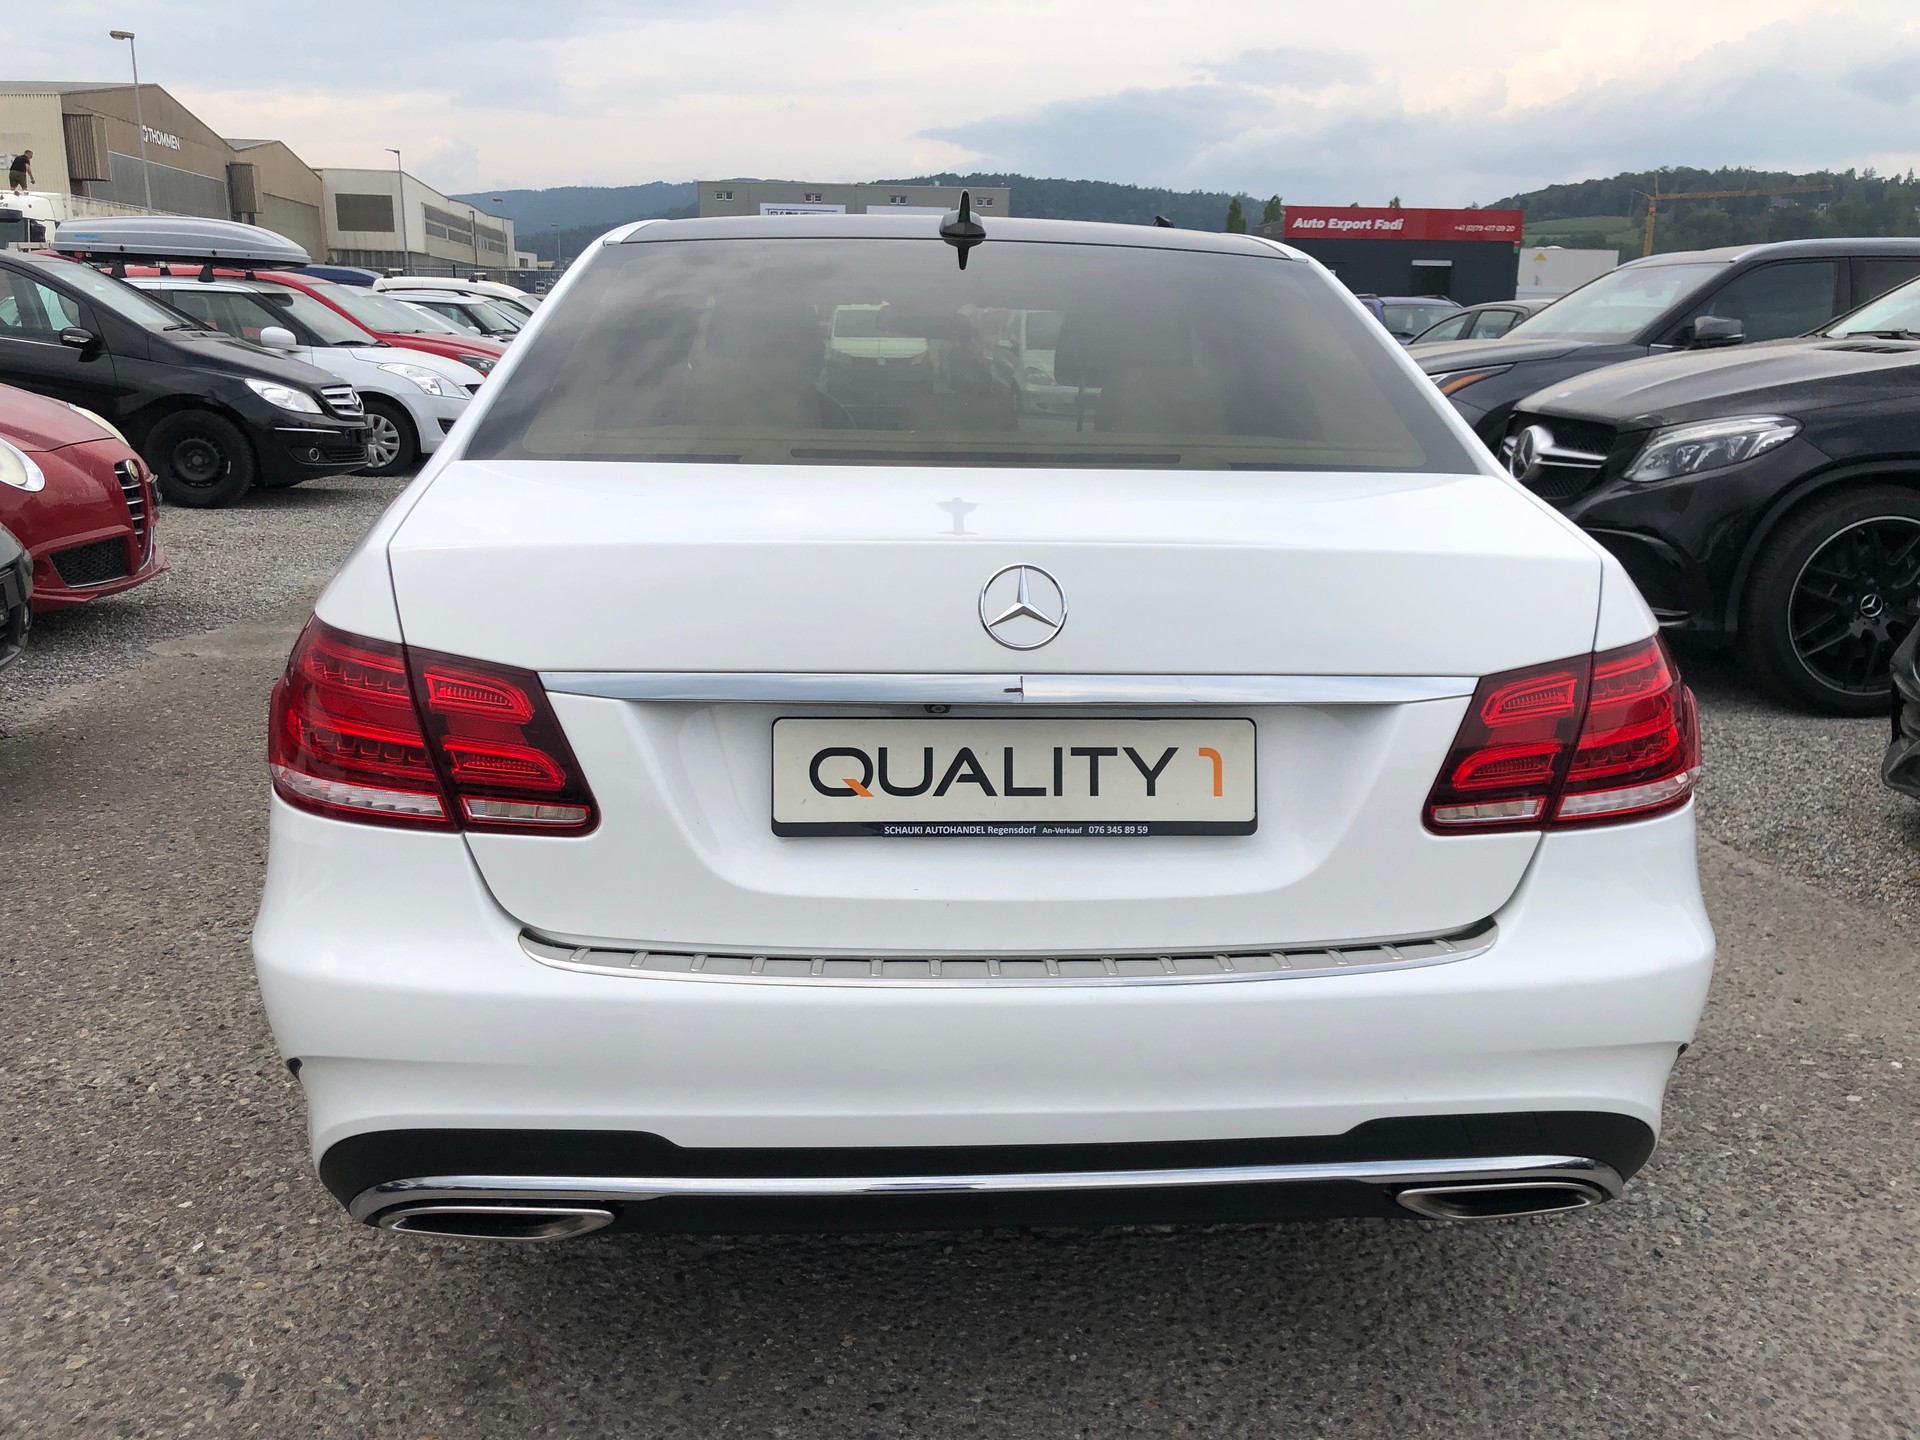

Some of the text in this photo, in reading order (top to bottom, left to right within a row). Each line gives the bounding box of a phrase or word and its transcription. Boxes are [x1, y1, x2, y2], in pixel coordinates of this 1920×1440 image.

[147, 127, 180, 151] THOMMEN
[1292, 217, 1405, 231] Auto Export Fadi
[809, 747, 1222, 797] QUALITY 1
[884, 826, 923, 834] SCHAUKI
[925, 826, 986, 834] AUTOHANDEL
[987, 826, 1037, 836] Regensdorf
[1088, 826, 1105, 834] 076
[1106, 826, 1123, 834] 345
[1124, 826, 1136, 834] 89
[1137, 826, 1149, 834] 59
